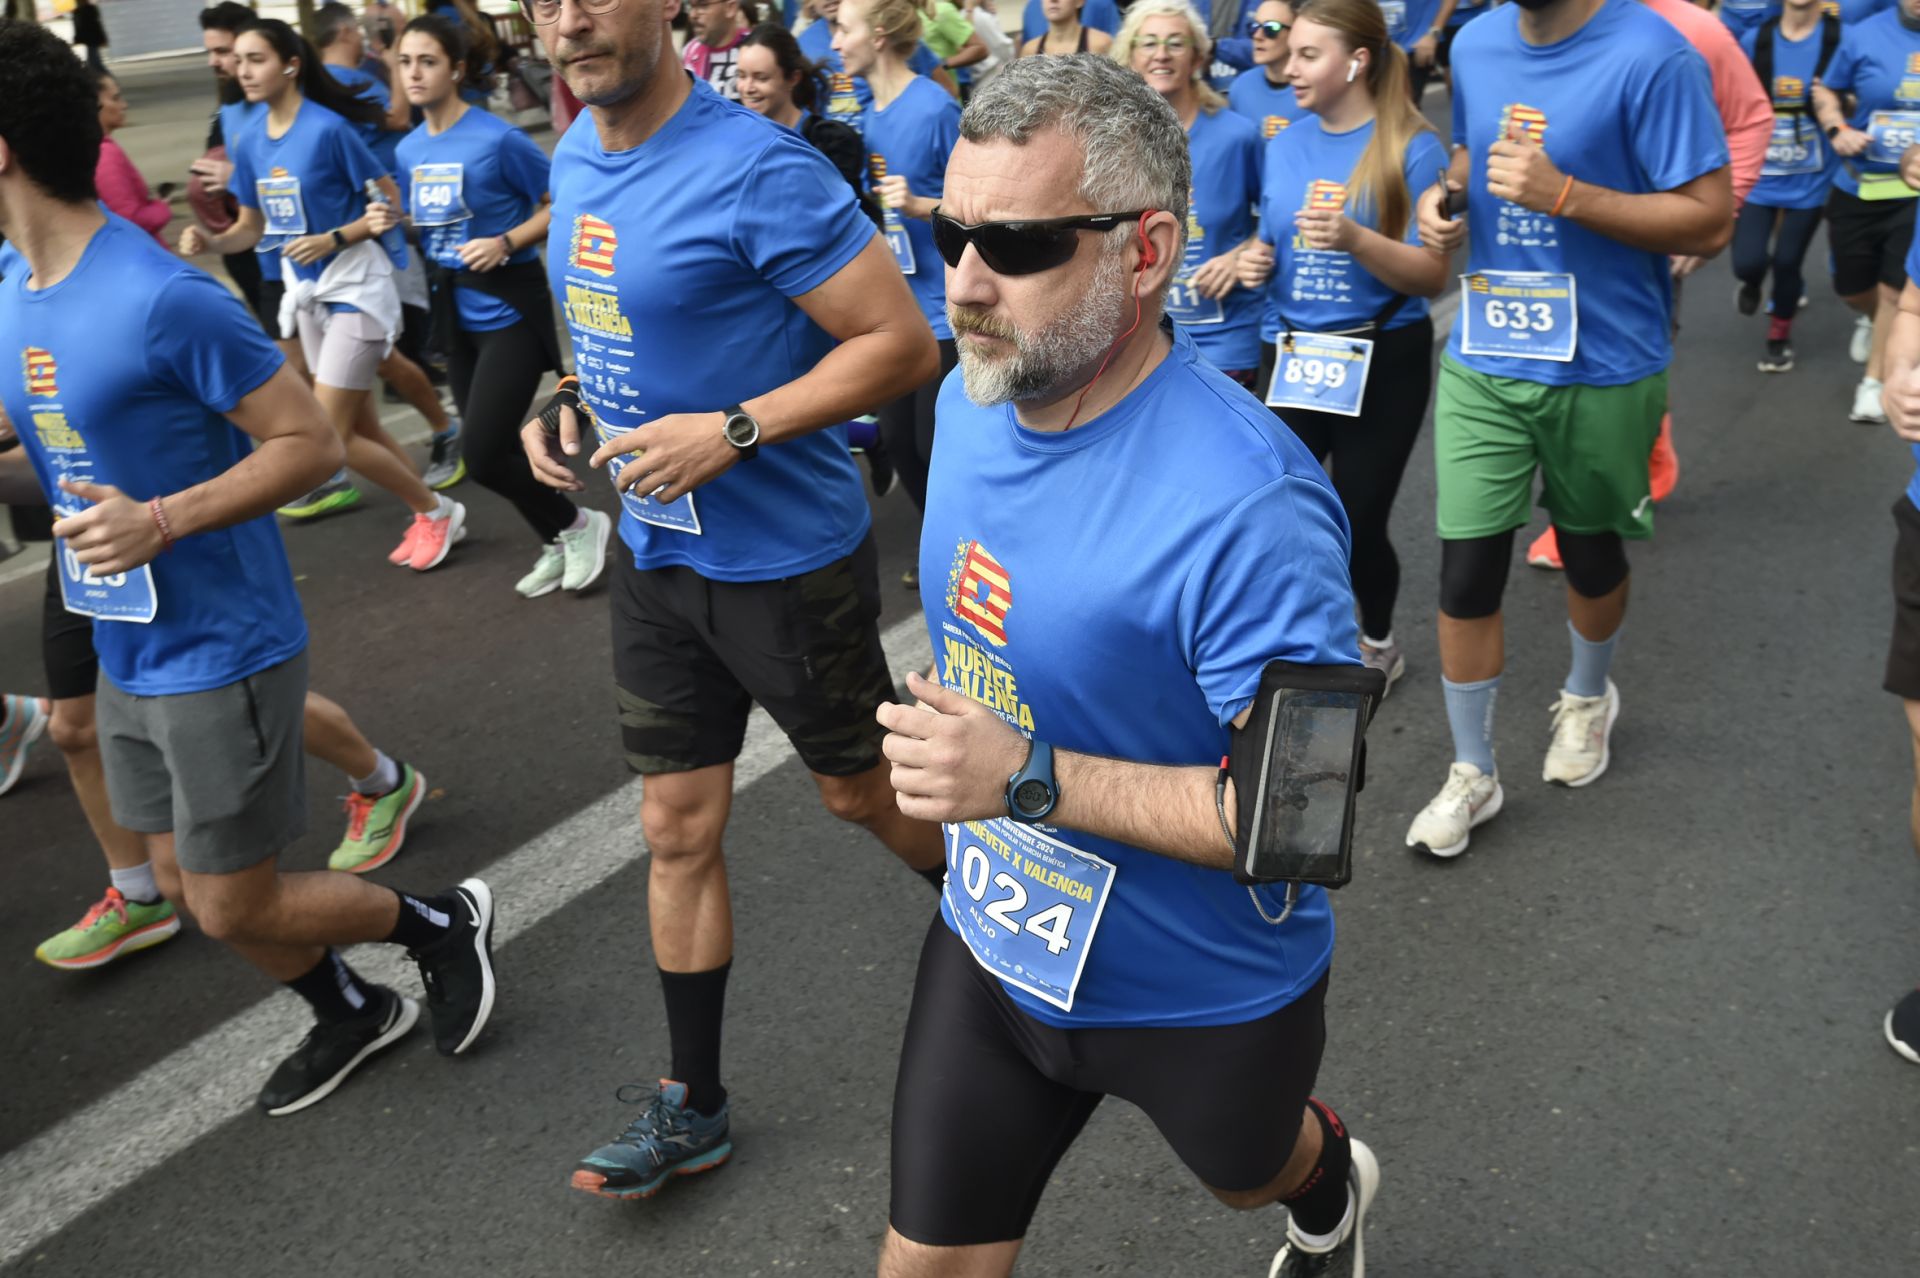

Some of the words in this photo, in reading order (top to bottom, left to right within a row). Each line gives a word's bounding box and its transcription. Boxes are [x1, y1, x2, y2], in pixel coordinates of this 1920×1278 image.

[1485, 299, 1554, 332] 633
[1284, 358, 1347, 389] 899
[955, 667, 1036, 732] ALENIA
[1002, 819, 1036, 845] NOVIEMBRE
[1036, 841, 1055, 855] 2024
[947, 823, 1075, 957] 1024
[1011, 851, 1023, 871] X
[1023, 859, 1094, 904] VALENCIA
[969, 905, 996, 939] ALEJO
